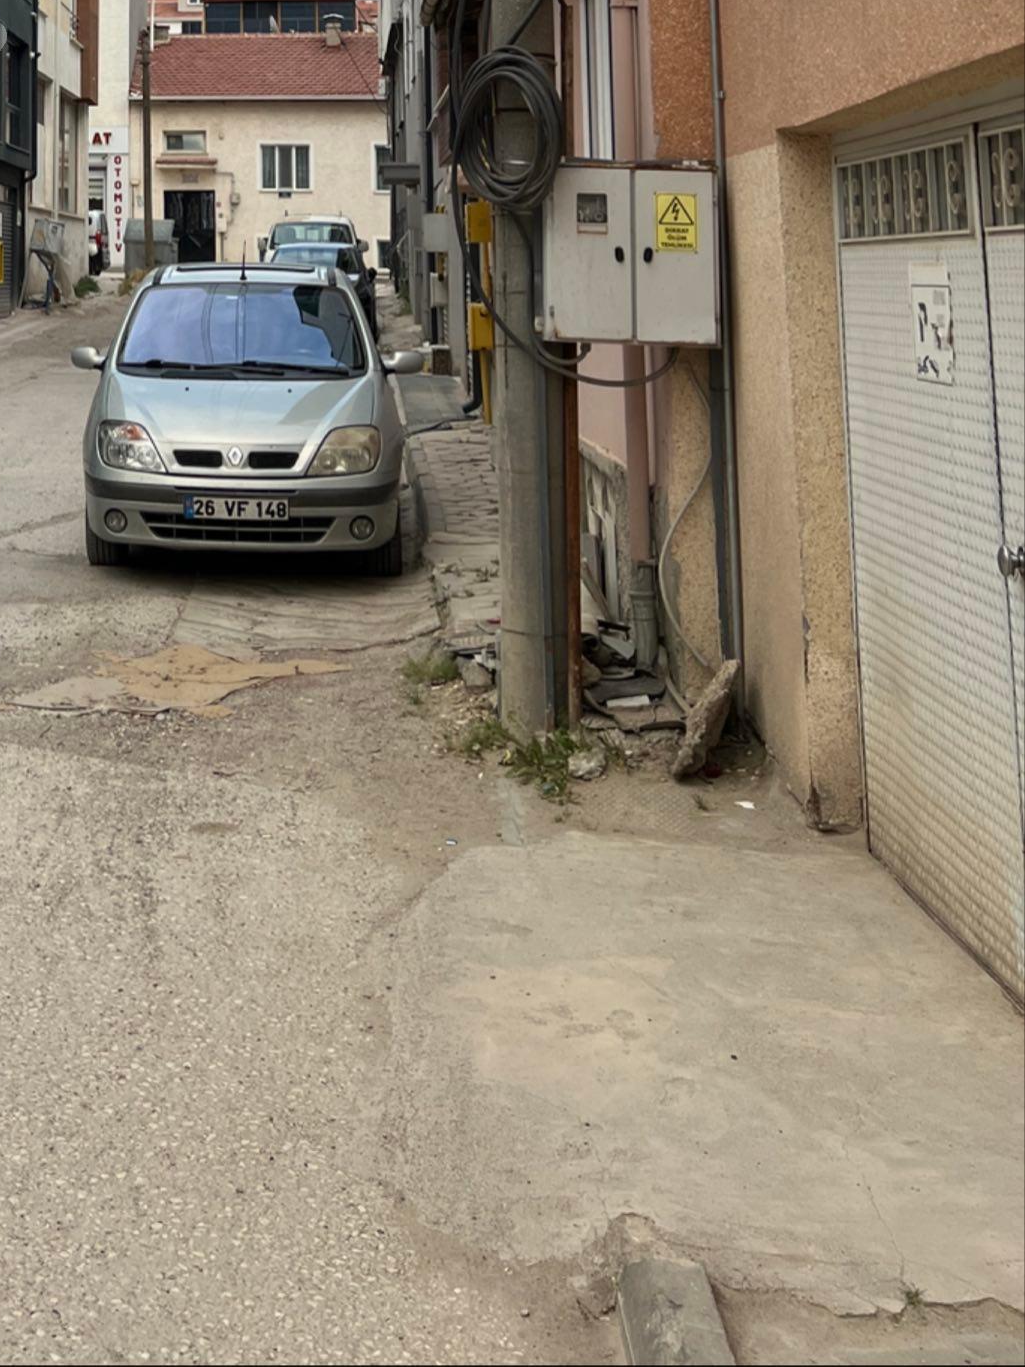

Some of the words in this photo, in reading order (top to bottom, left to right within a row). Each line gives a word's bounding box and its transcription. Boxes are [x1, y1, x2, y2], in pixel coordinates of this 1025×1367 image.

[92, 132, 112, 146] AT
[194, 499, 215, 516] 26
[224, 500, 249, 517] VF
[256, 501, 287, 518] 148
